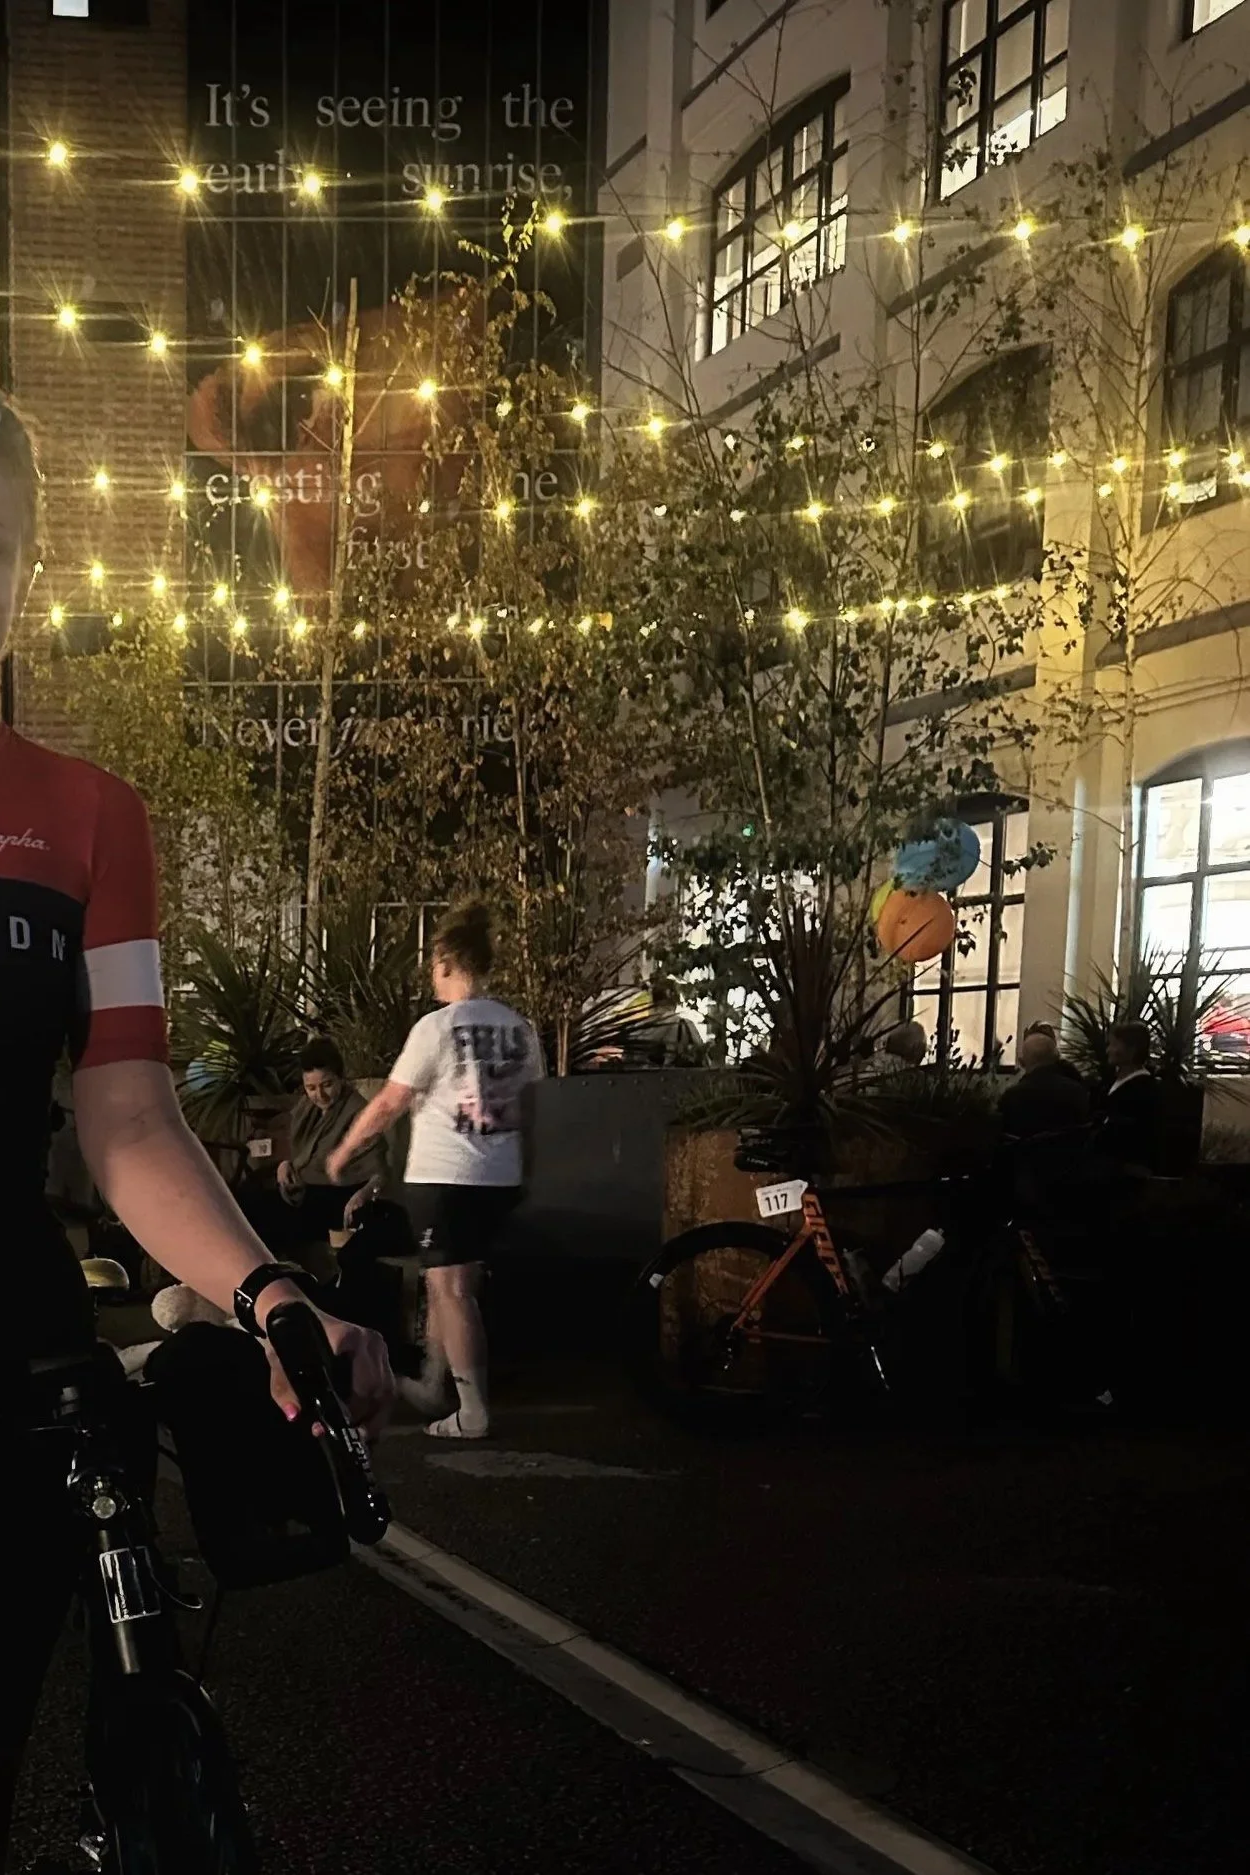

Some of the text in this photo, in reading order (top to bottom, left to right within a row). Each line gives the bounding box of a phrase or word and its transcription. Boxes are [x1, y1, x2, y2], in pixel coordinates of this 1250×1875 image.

[205, 83, 574, 141] It's seeing the
[401, 152, 573, 201] sunrise,
[205, 463, 382, 517] crestig
[765, 1193, 788, 1212] 117
